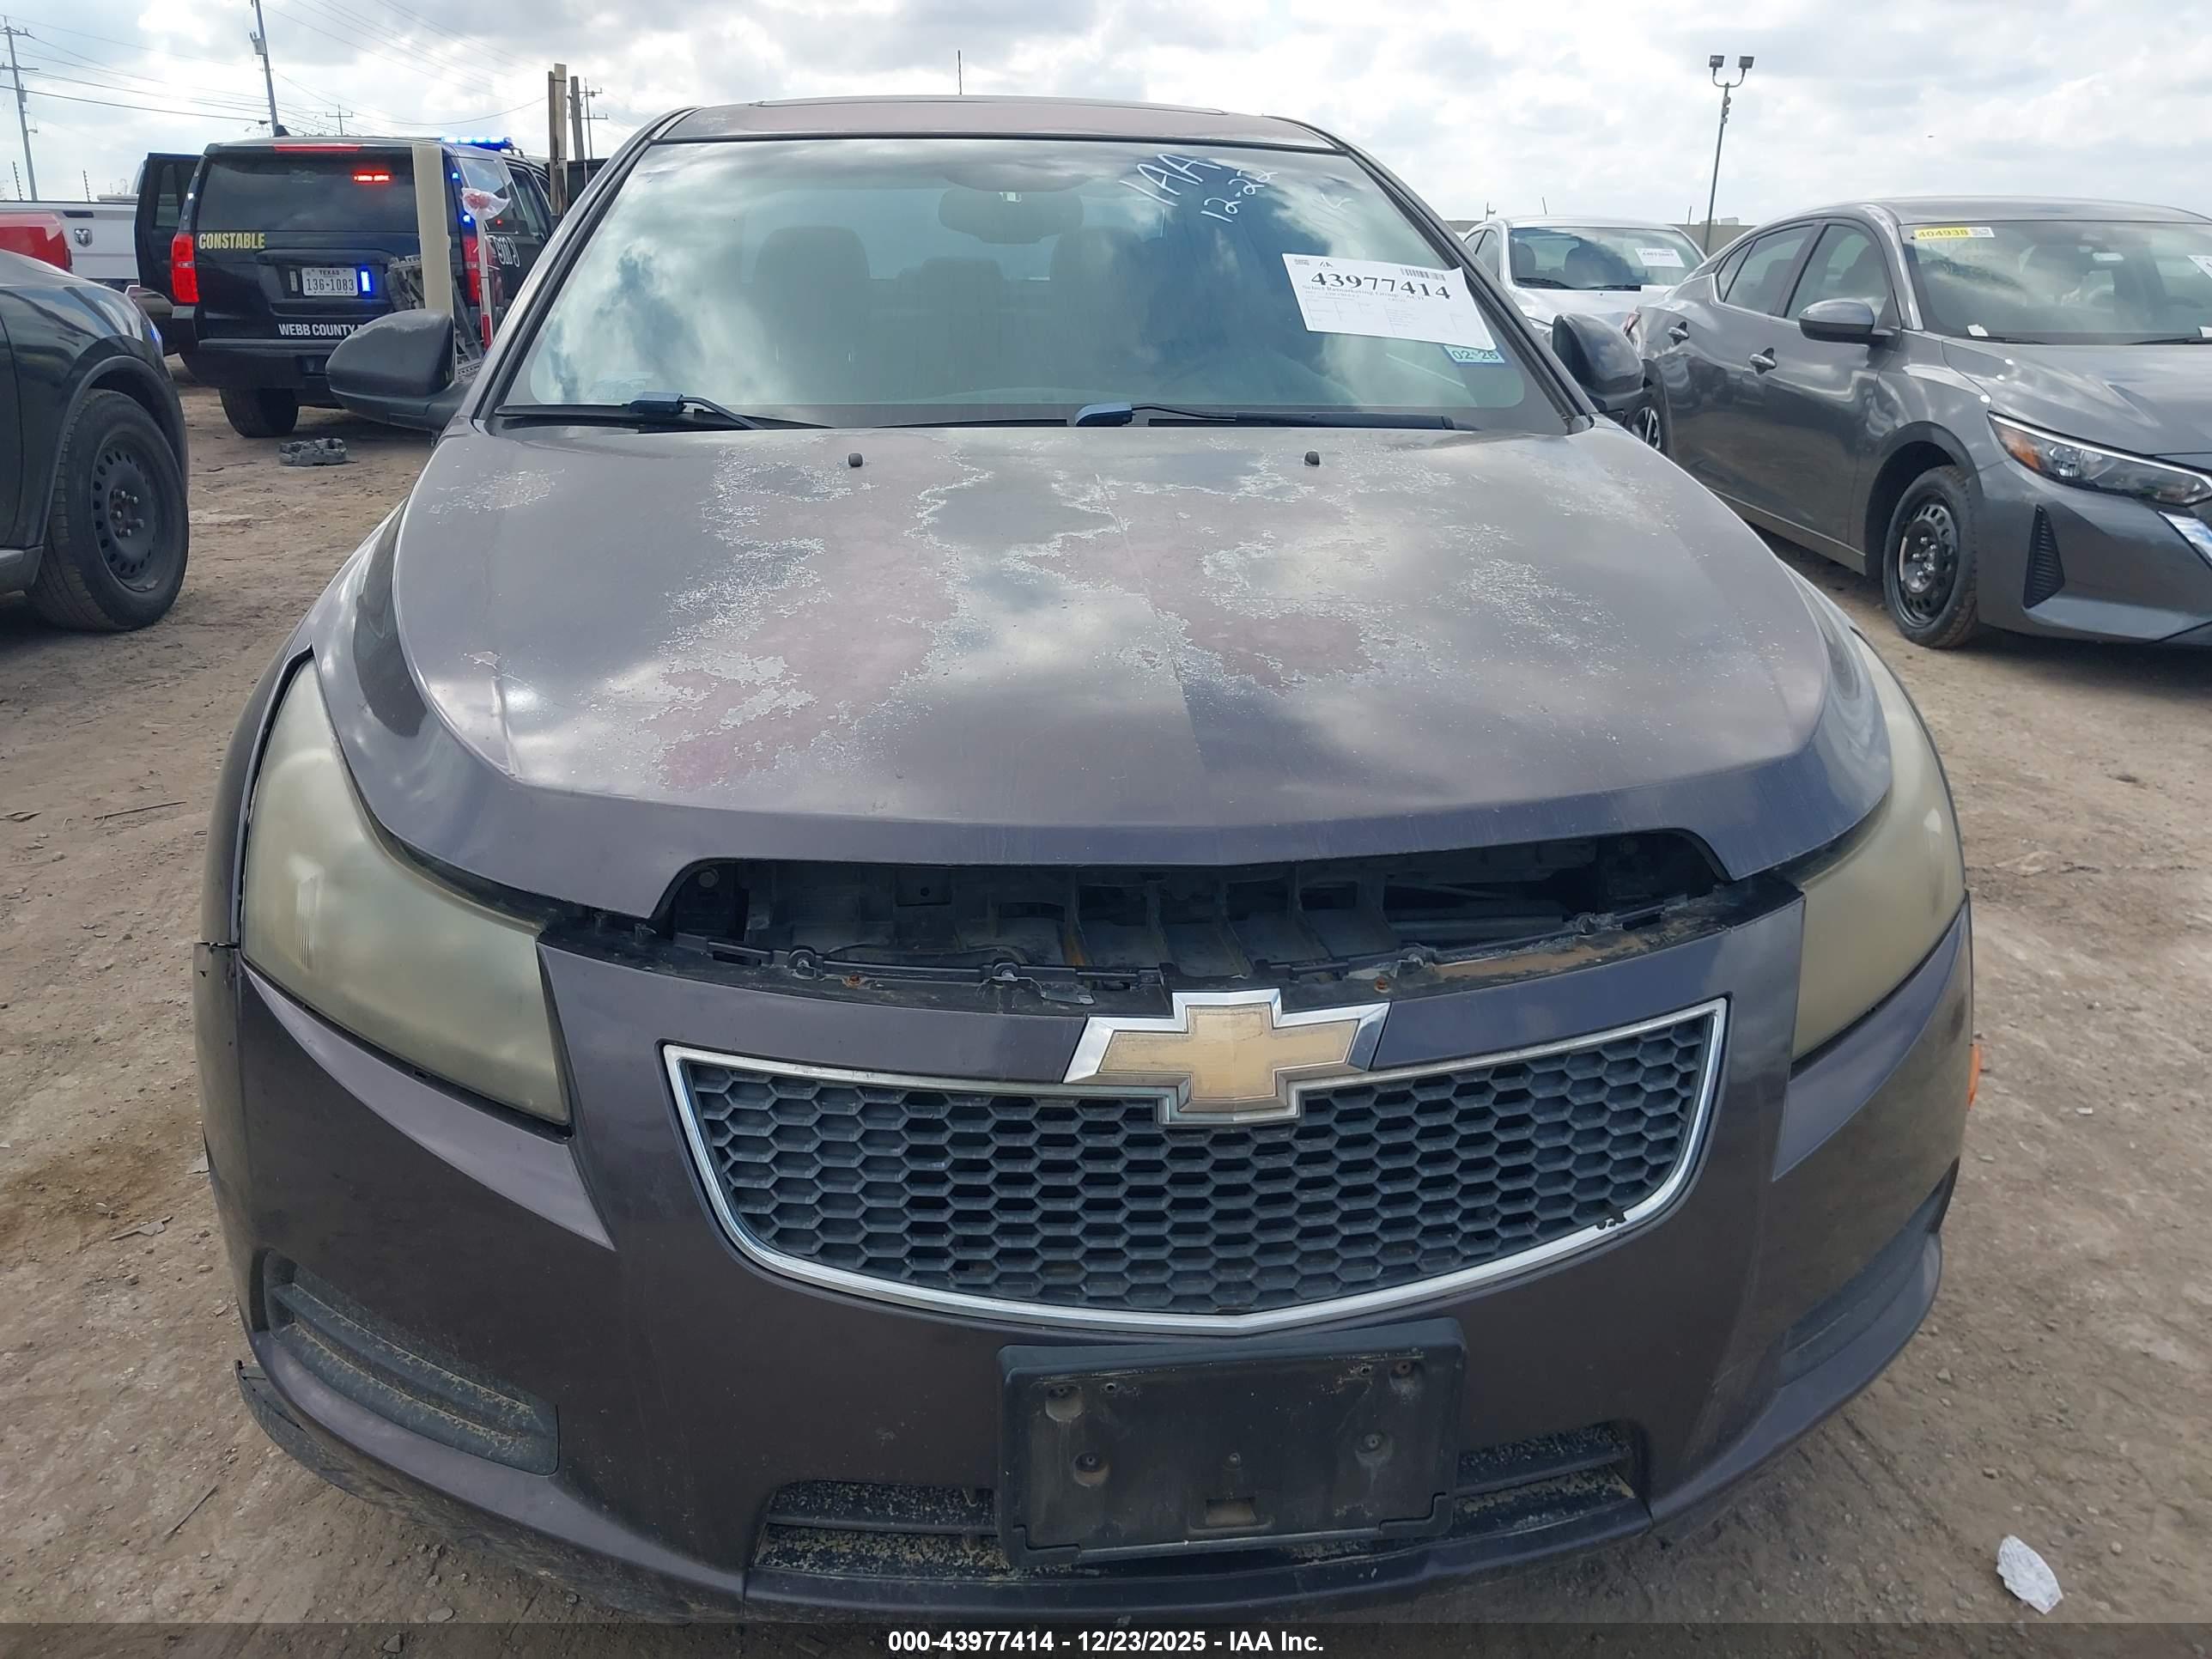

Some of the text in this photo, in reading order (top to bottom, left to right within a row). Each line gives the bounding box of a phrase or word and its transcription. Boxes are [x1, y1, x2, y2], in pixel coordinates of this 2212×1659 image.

[1119, 153, 1222, 207] IAA
[198, 233, 265, 250] CONSTABLE
[1311, 272, 1450, 300] 43977414
[278, 324, 311, 336] WEBB
[312, 324, 356, 337] COUNTY
